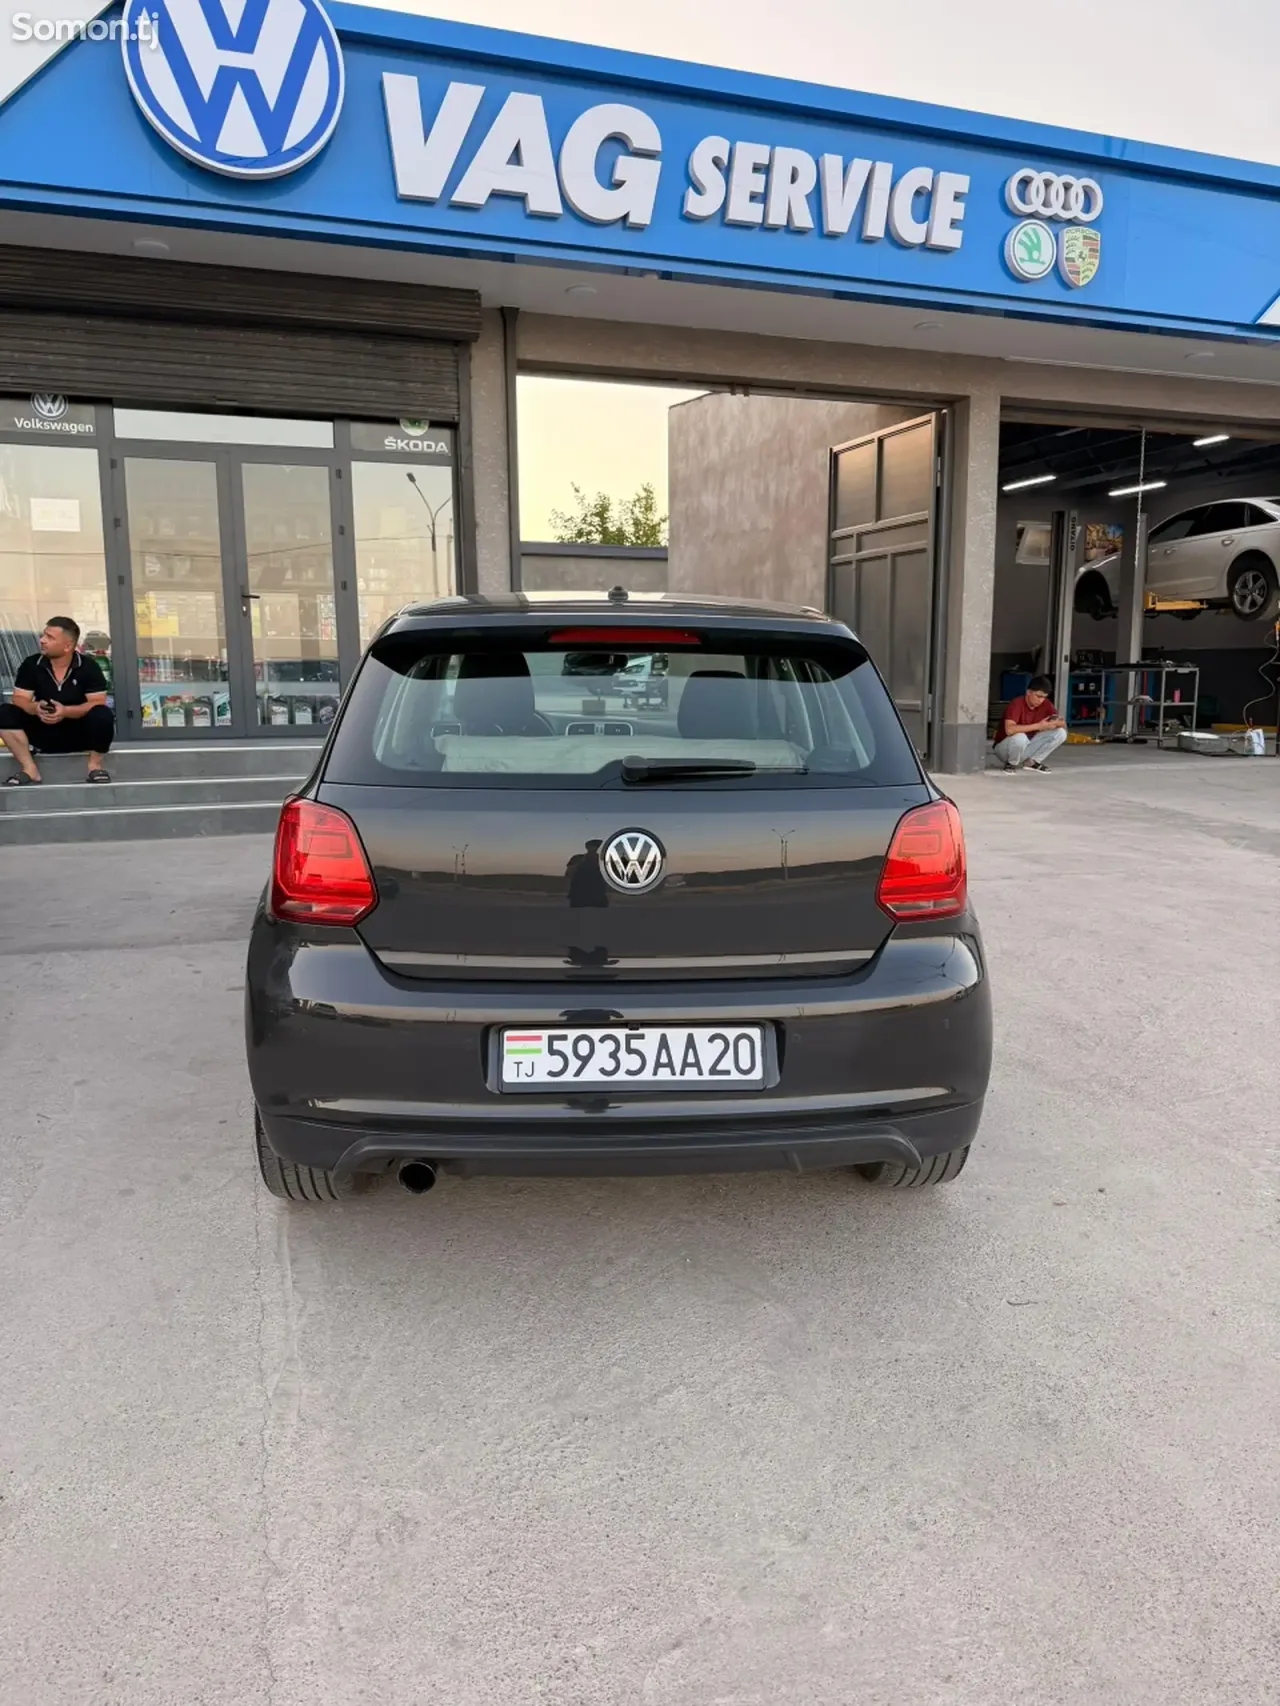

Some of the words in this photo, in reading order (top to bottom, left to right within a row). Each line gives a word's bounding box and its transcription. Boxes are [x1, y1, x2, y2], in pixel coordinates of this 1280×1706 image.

[381, 71, 662, 229] VAG
[683, 135, 970, 251] SERVICE
[14, 417, 94, 434] Volkswagen
[384, 436, 449, 453] ŠKODA
[546, 1032, 757, 1078] 5935AA20
[513, 1061, 535, 1078] TJ
